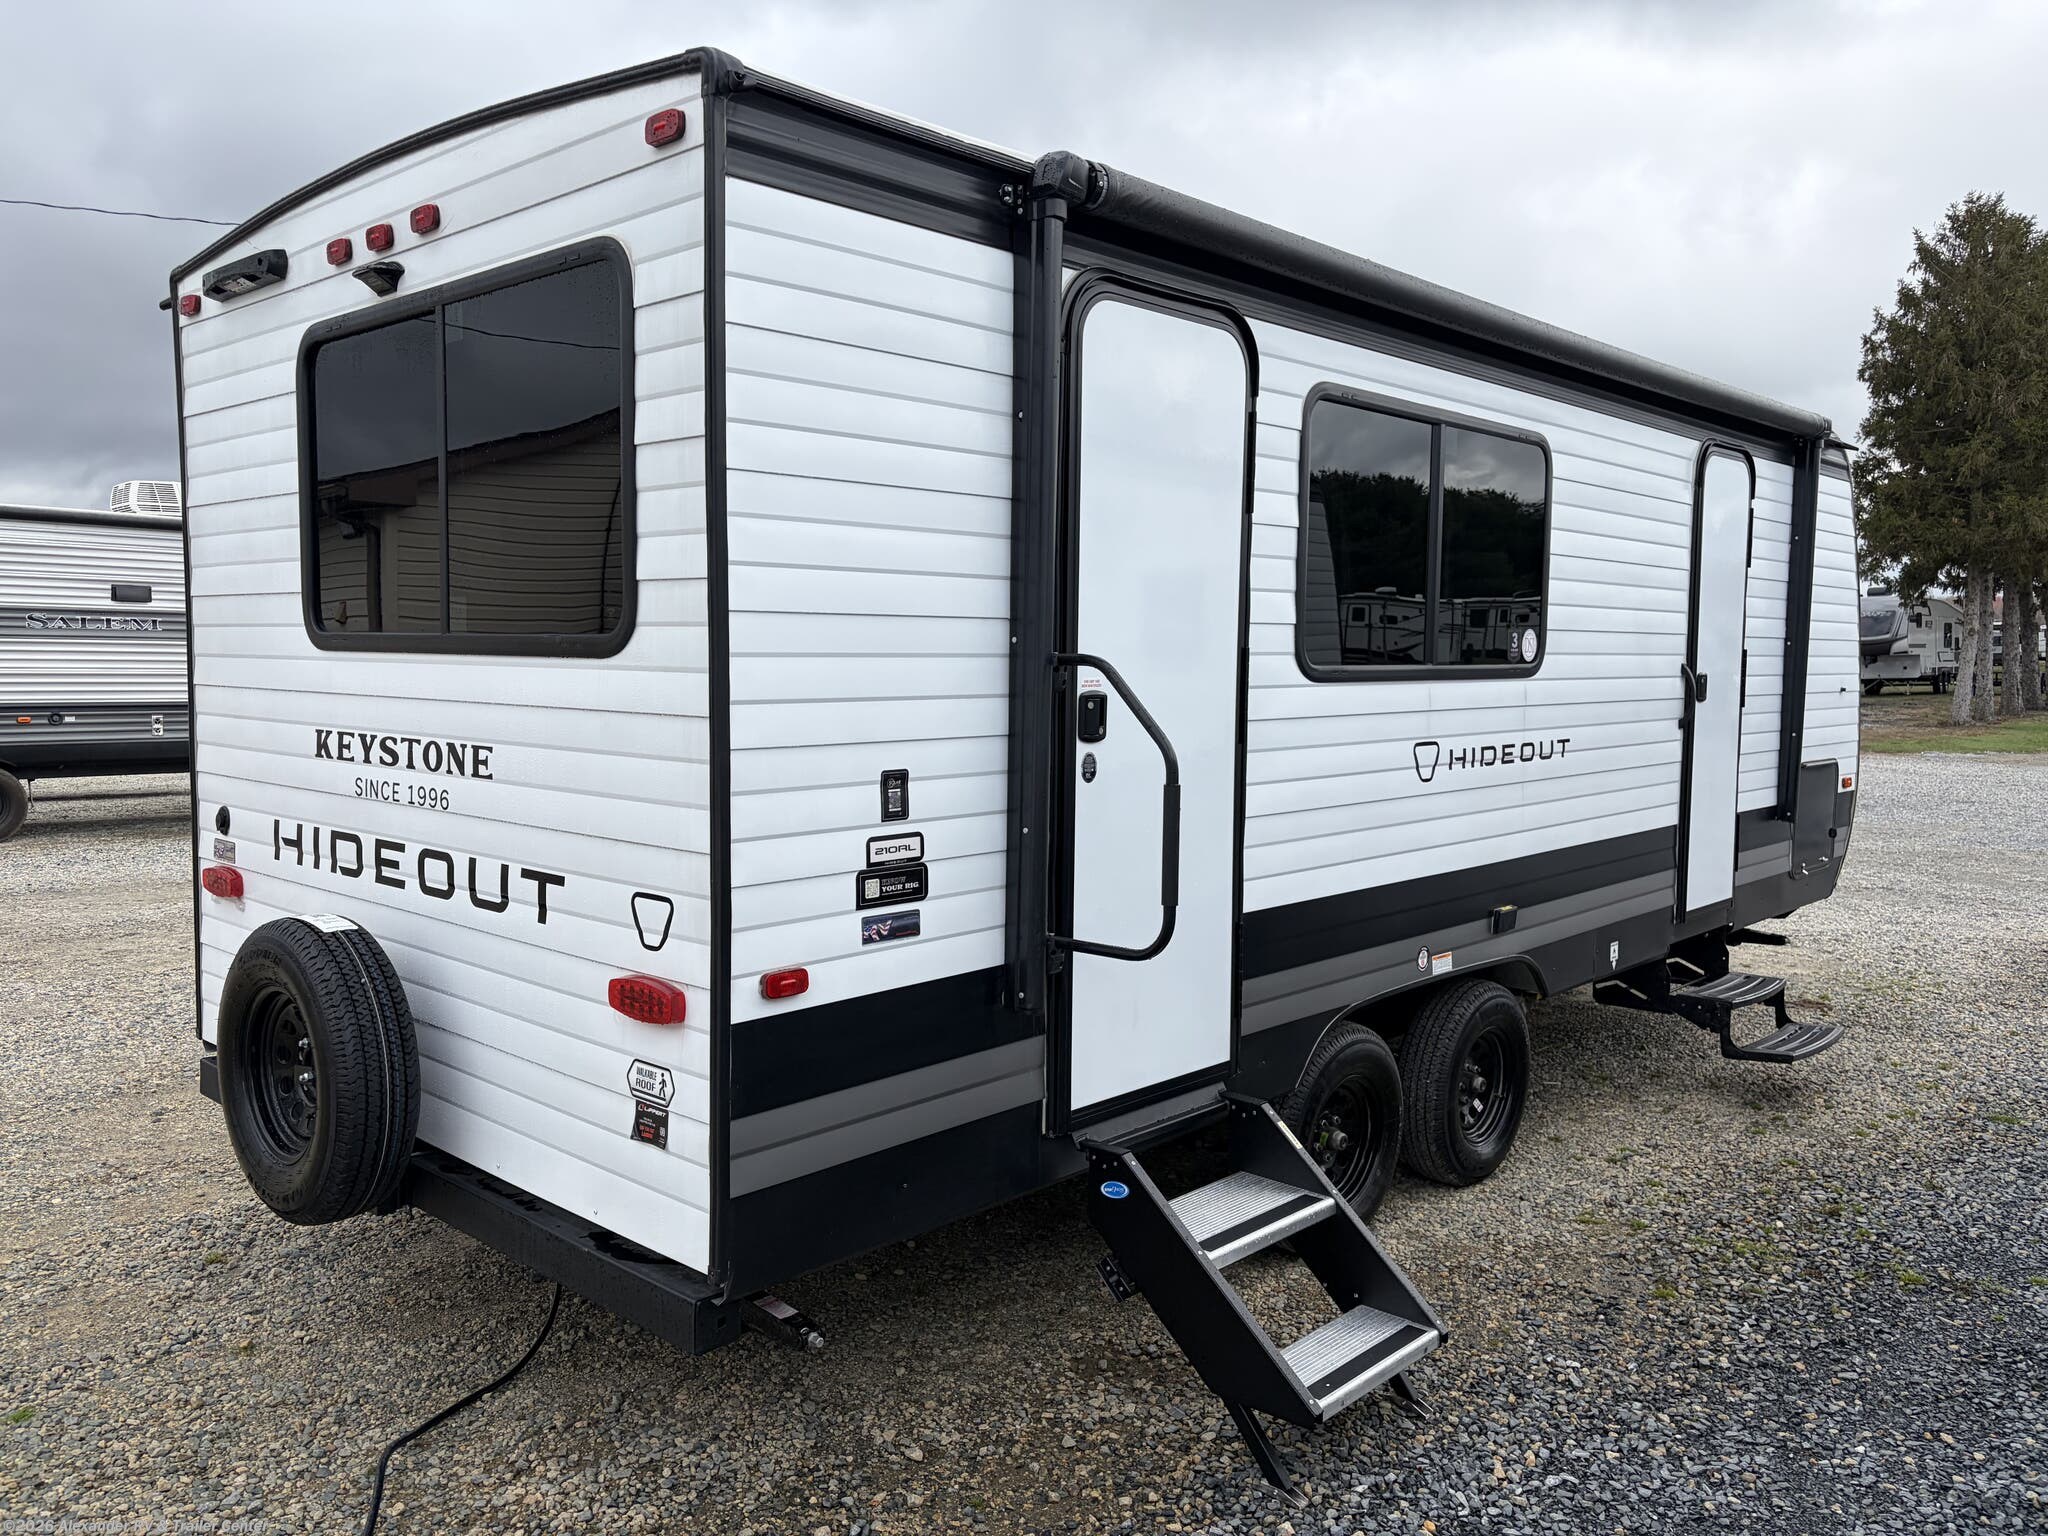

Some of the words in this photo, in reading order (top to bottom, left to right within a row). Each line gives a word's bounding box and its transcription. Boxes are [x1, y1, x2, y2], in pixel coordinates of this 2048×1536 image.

[315, 728, 494, 780] KEYSTONE
[1448, 738, 1571, 771] HIDEOUT
[354, 777, 401, 803] SINCE
[407, 784, 450, 811] 1996
[273, 819, 566, 925] HIDEOUT
[881, 884, 903, 893] YOUR
[635, 1077, 656, 1092] ROOF
